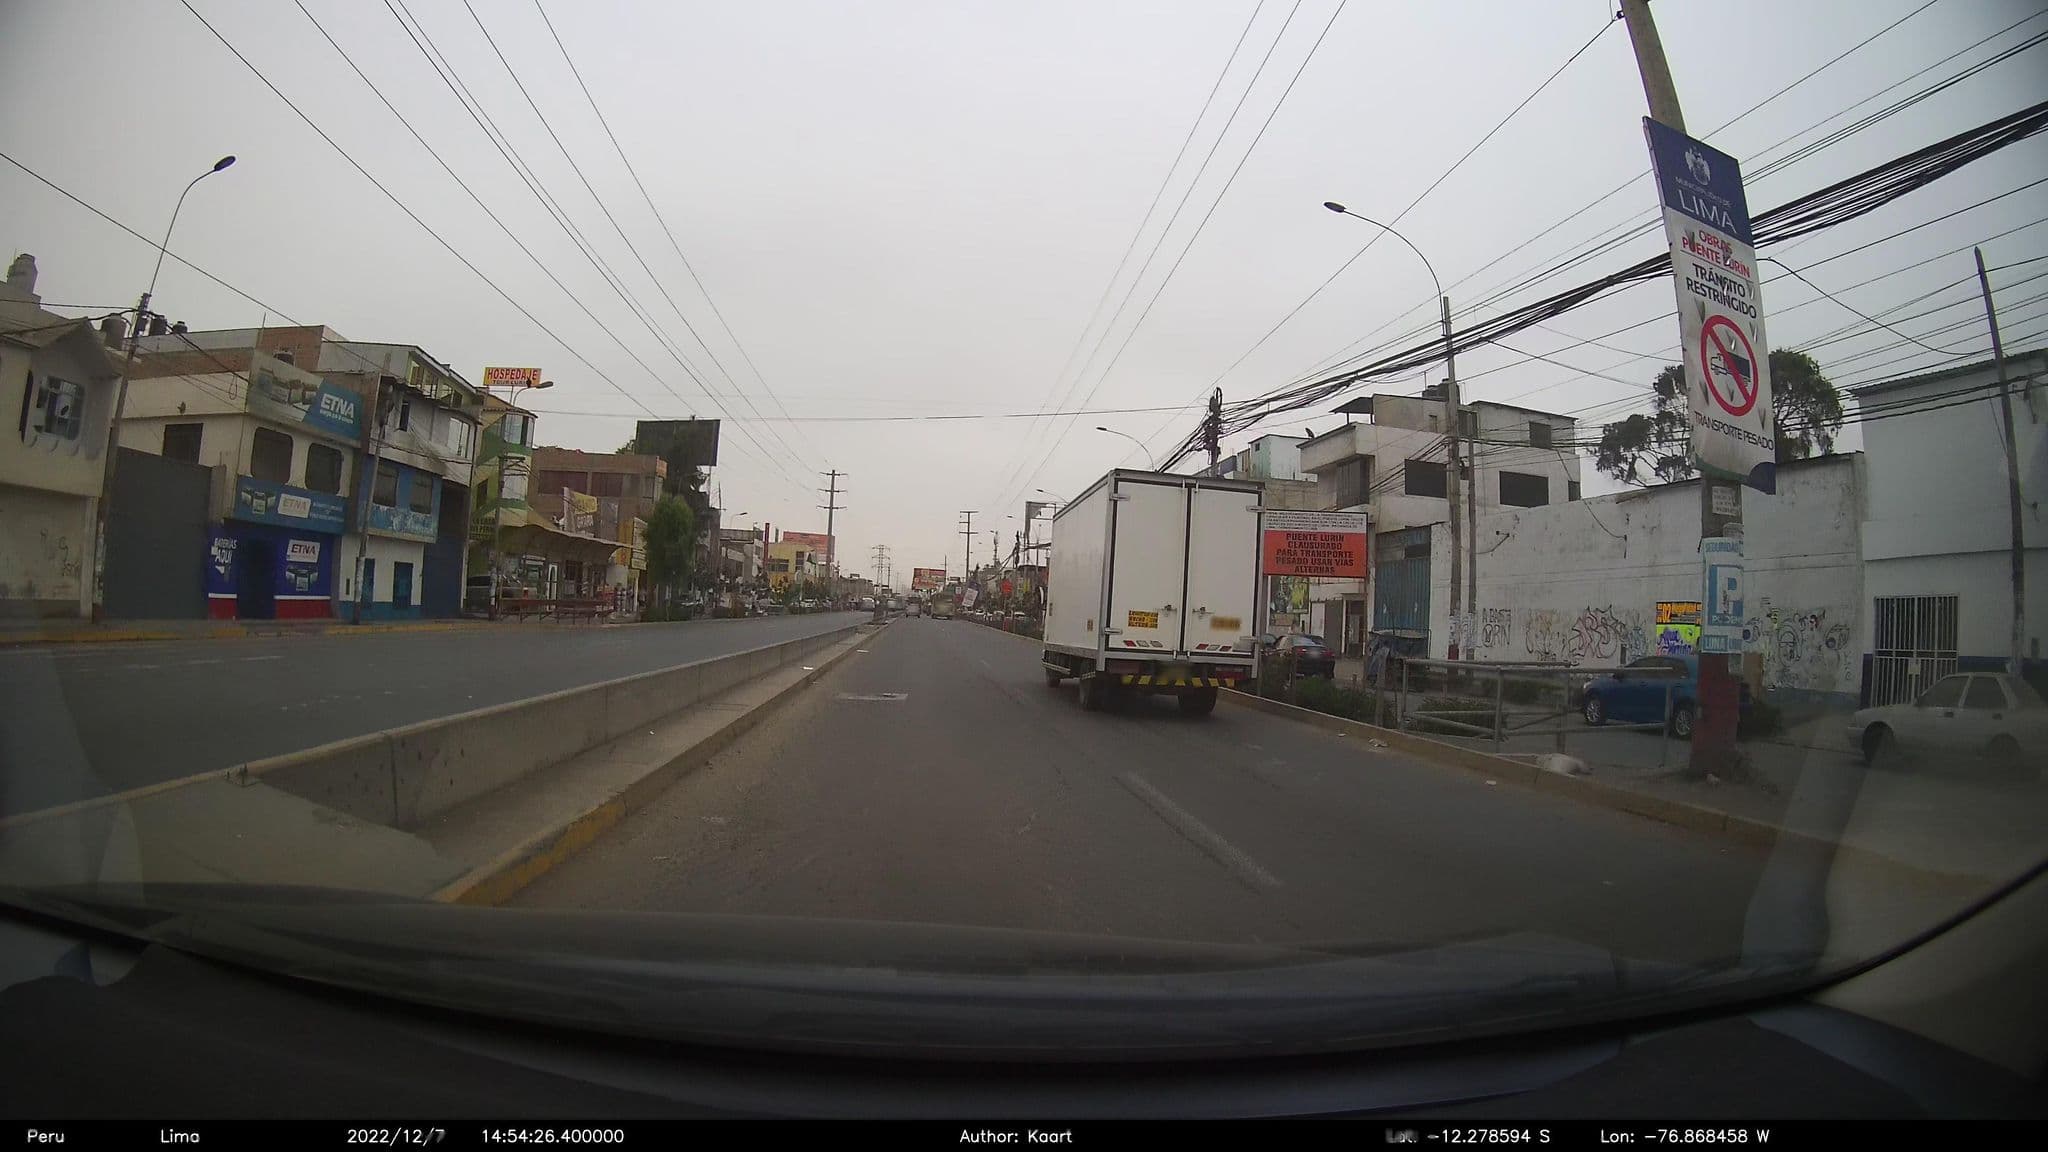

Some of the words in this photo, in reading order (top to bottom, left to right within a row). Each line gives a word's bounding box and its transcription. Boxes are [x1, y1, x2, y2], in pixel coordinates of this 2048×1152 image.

[1679, 188, 1738, 234] LIMA
[1698, 229, 1733, 256] OBRAS
[1682, 236, 1721, 264] PUENTE
[1692, 262, 1746, 298] TRÁNSITO
[1686, 276, 1758, 319] RESTRINGIDO
[487, 369, 539, 381] HOSPEDAJE
[320, 393, 355, 419] ETNA
[1694, 410, 1743, 440] TRANSPORTE
[1743, 430, 1775, 451] PESADO
[282, 498, 308, 511] ETNA
[1286, 532, 1319, 542] PUENTE
[290, 543, 317, 556] ETNA
[1287, 541, 1343, 551] CLAUSURADO
[1276, 548, 1298, 558] PARA
[1300, 549, 1354, 559] TRANSPORTE
[1276, 556, 1309, 566] PESADO
[1311, 558, 1334, 567] USAR
[1294, 565, 1336, 574] ALTERNAS
